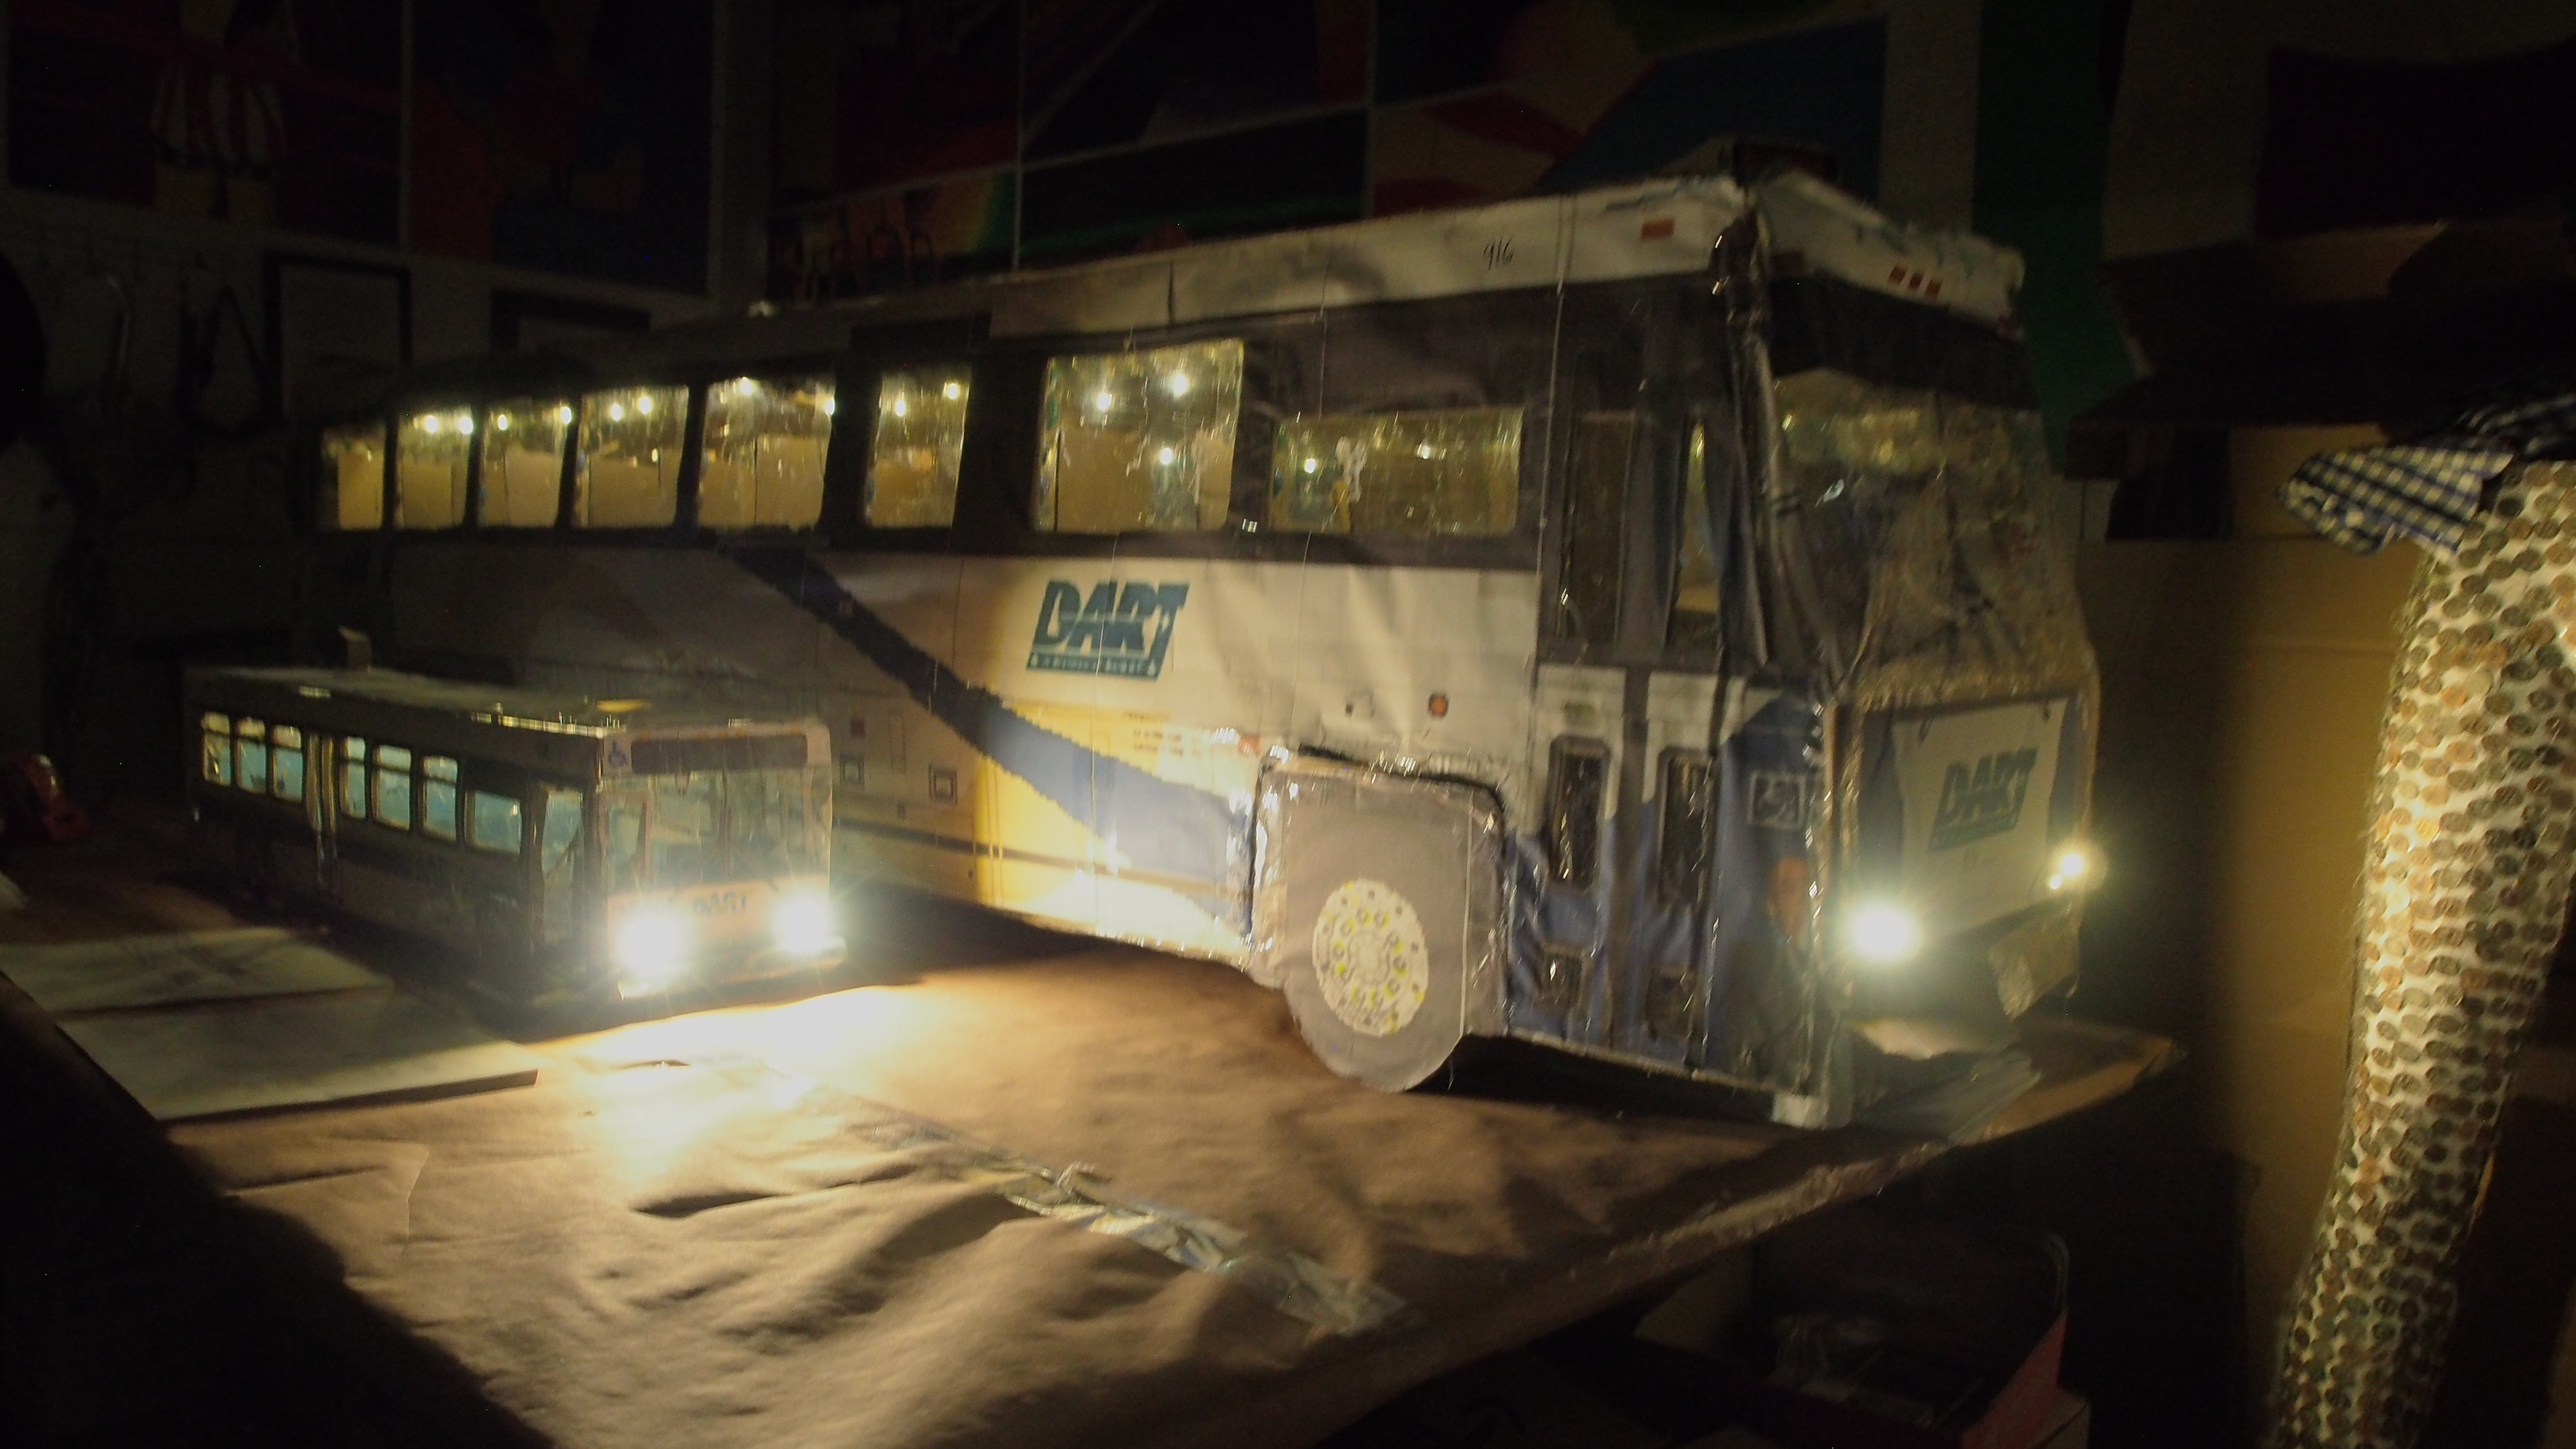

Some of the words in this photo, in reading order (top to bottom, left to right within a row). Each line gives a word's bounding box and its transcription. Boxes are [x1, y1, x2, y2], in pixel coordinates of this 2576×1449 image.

[1483, 236, 1514, 270] 916
[1029, 579, 1189, 671] DART
[1932, 747, 2038, 840] DART
